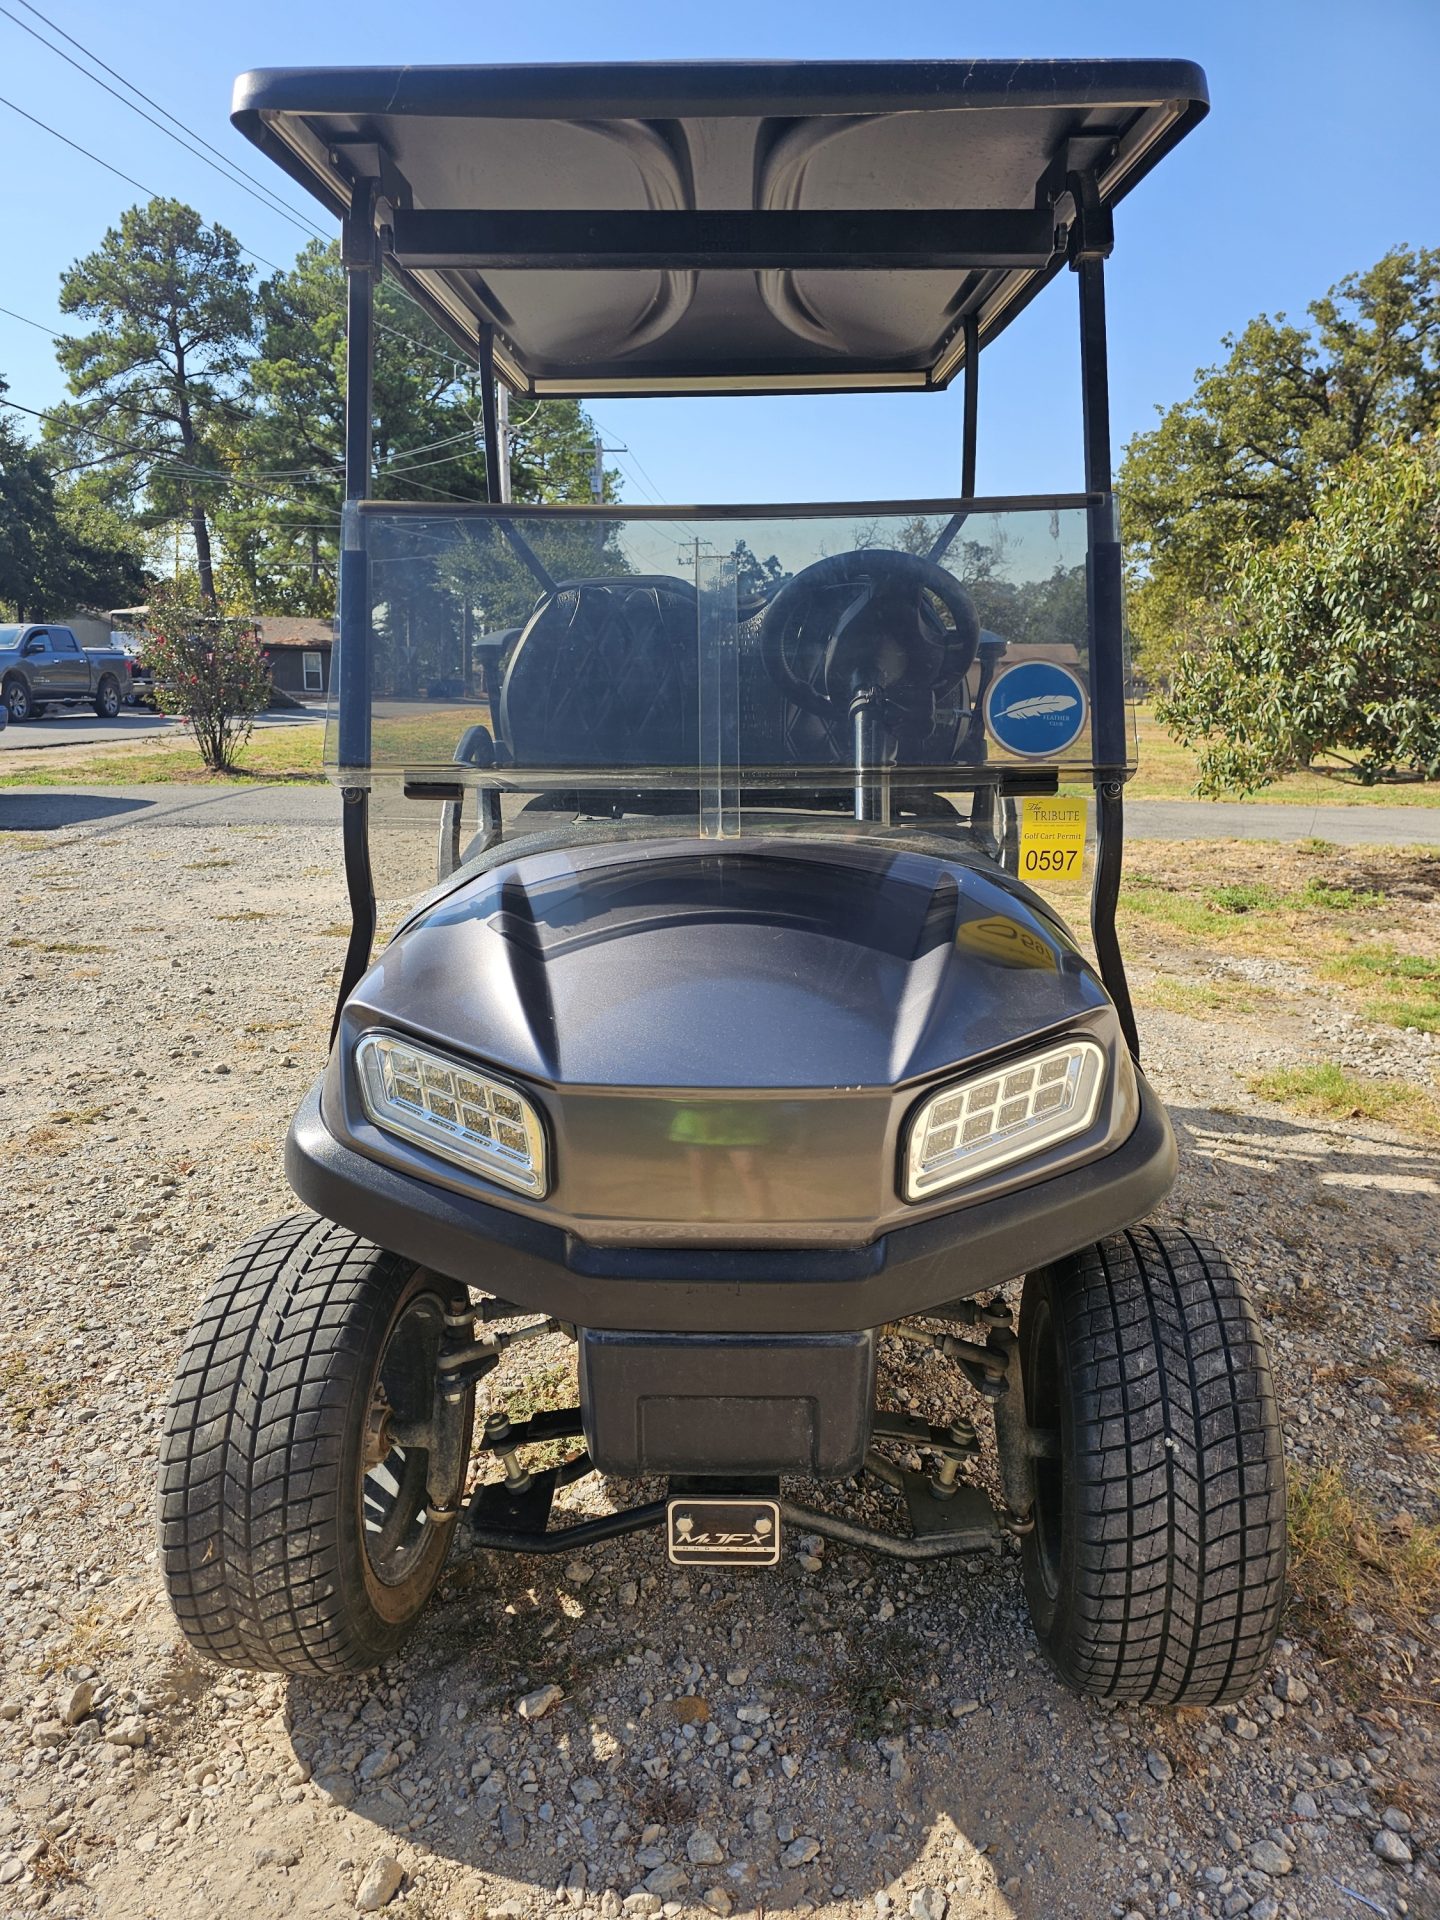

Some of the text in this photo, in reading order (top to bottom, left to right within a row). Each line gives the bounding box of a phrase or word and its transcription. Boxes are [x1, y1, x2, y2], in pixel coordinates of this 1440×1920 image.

[1026, 801, 1043, 811] The
[1033, 810, 1080, 821] TRIBUTE
[1024, 832, 1081, 840] Golf Cart Permit
[1025, 850, 1078, 871] 0597
